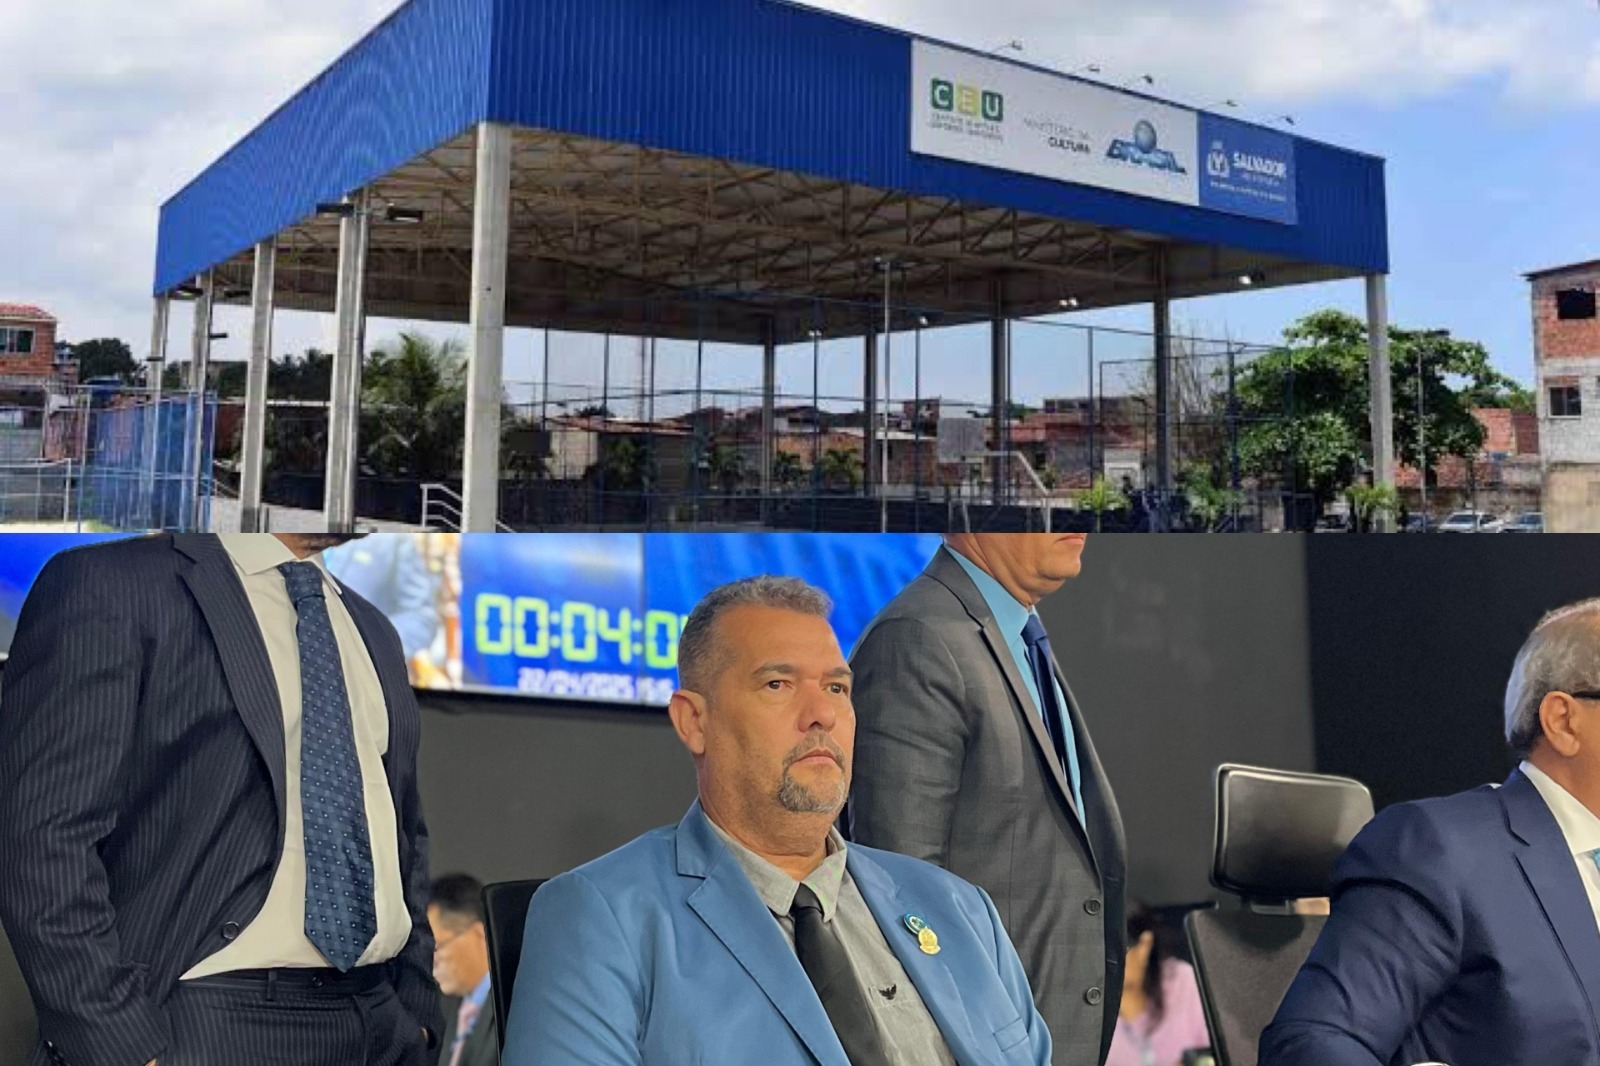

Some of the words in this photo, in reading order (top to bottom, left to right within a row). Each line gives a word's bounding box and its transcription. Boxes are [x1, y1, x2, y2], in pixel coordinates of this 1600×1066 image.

[931, 79, 1003, 122] CEU
[1048, 136, 1091, 154] CULTURA
[1233, 150, 1287, 178] SALVADOR
